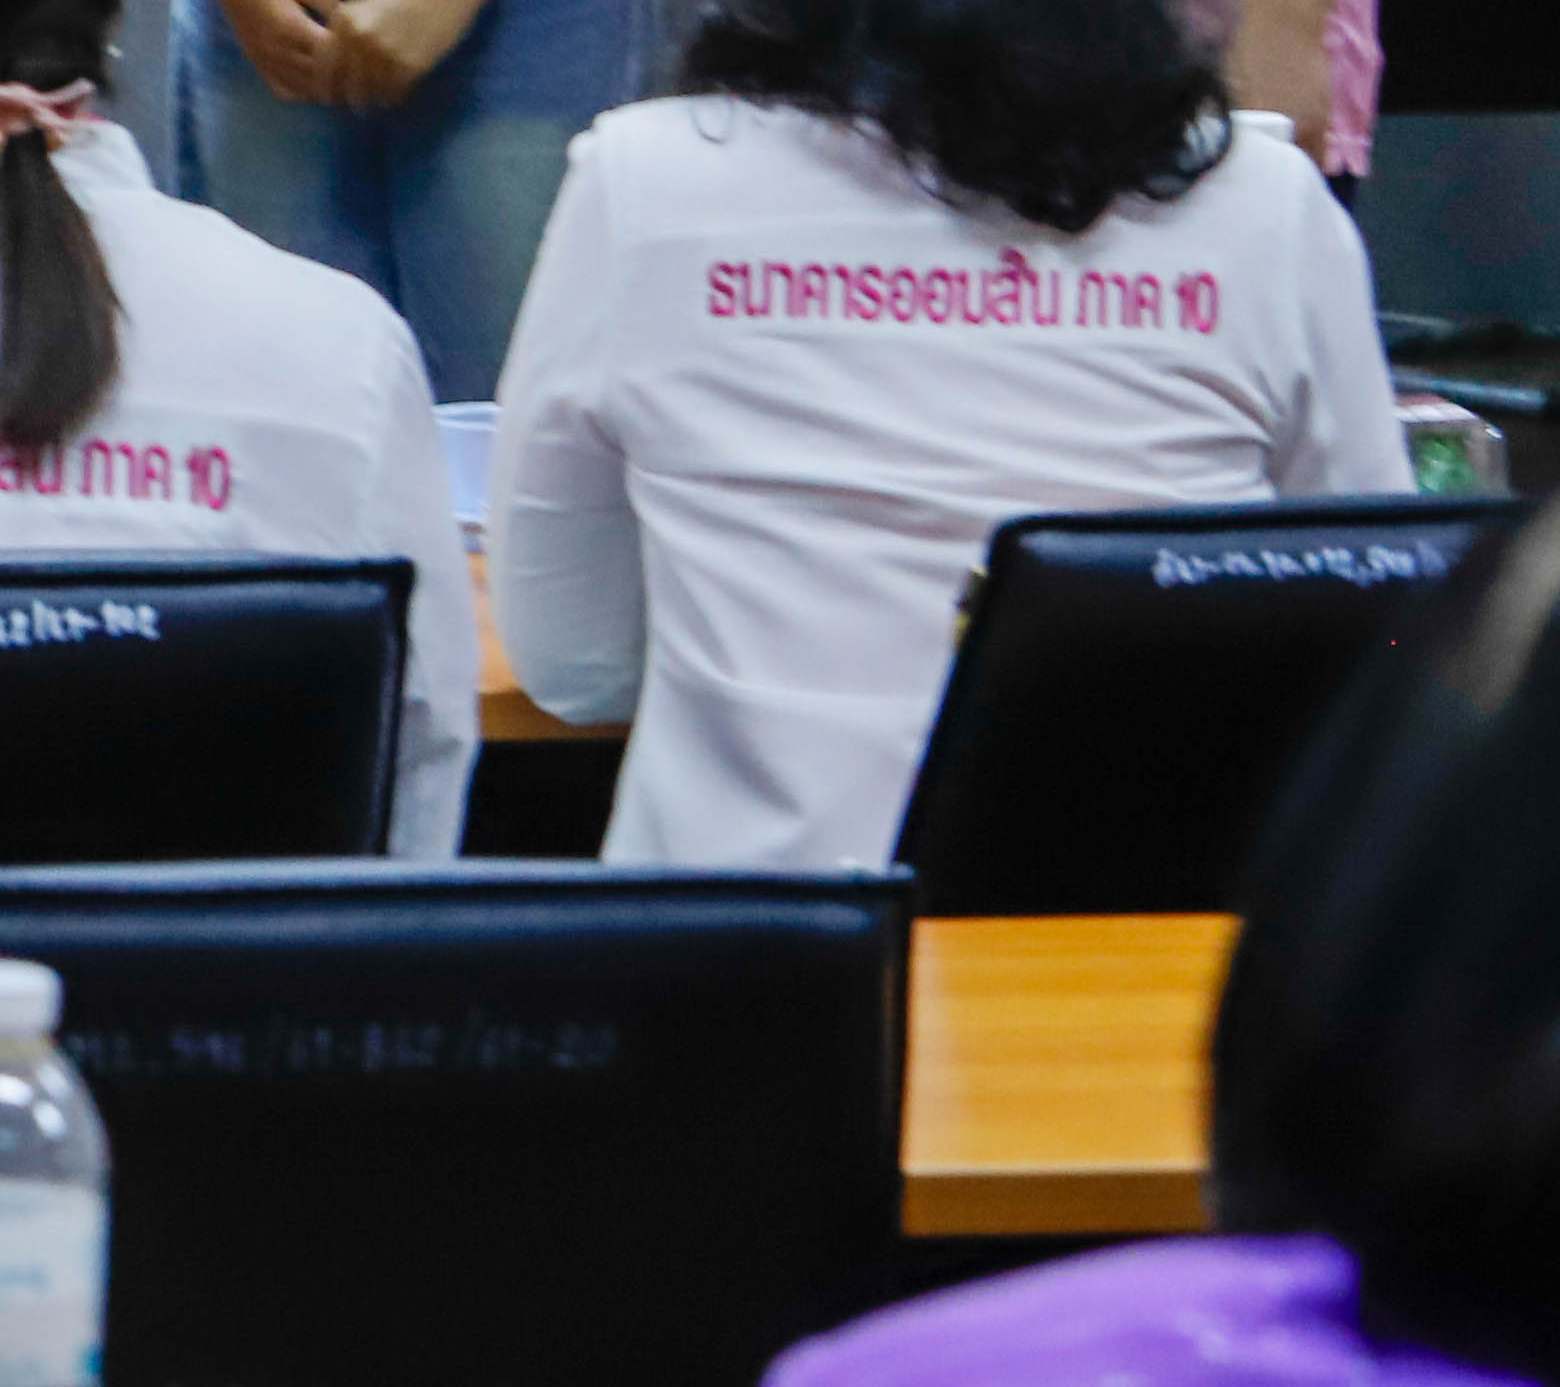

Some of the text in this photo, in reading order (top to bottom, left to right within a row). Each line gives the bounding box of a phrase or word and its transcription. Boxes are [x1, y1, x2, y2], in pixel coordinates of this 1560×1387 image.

[709, 248, 1219, 334] ธนาคารออมสิน ภาค 10
[81, 437, 172, 501] ภาค
[186, 445, 230, 511] 10
